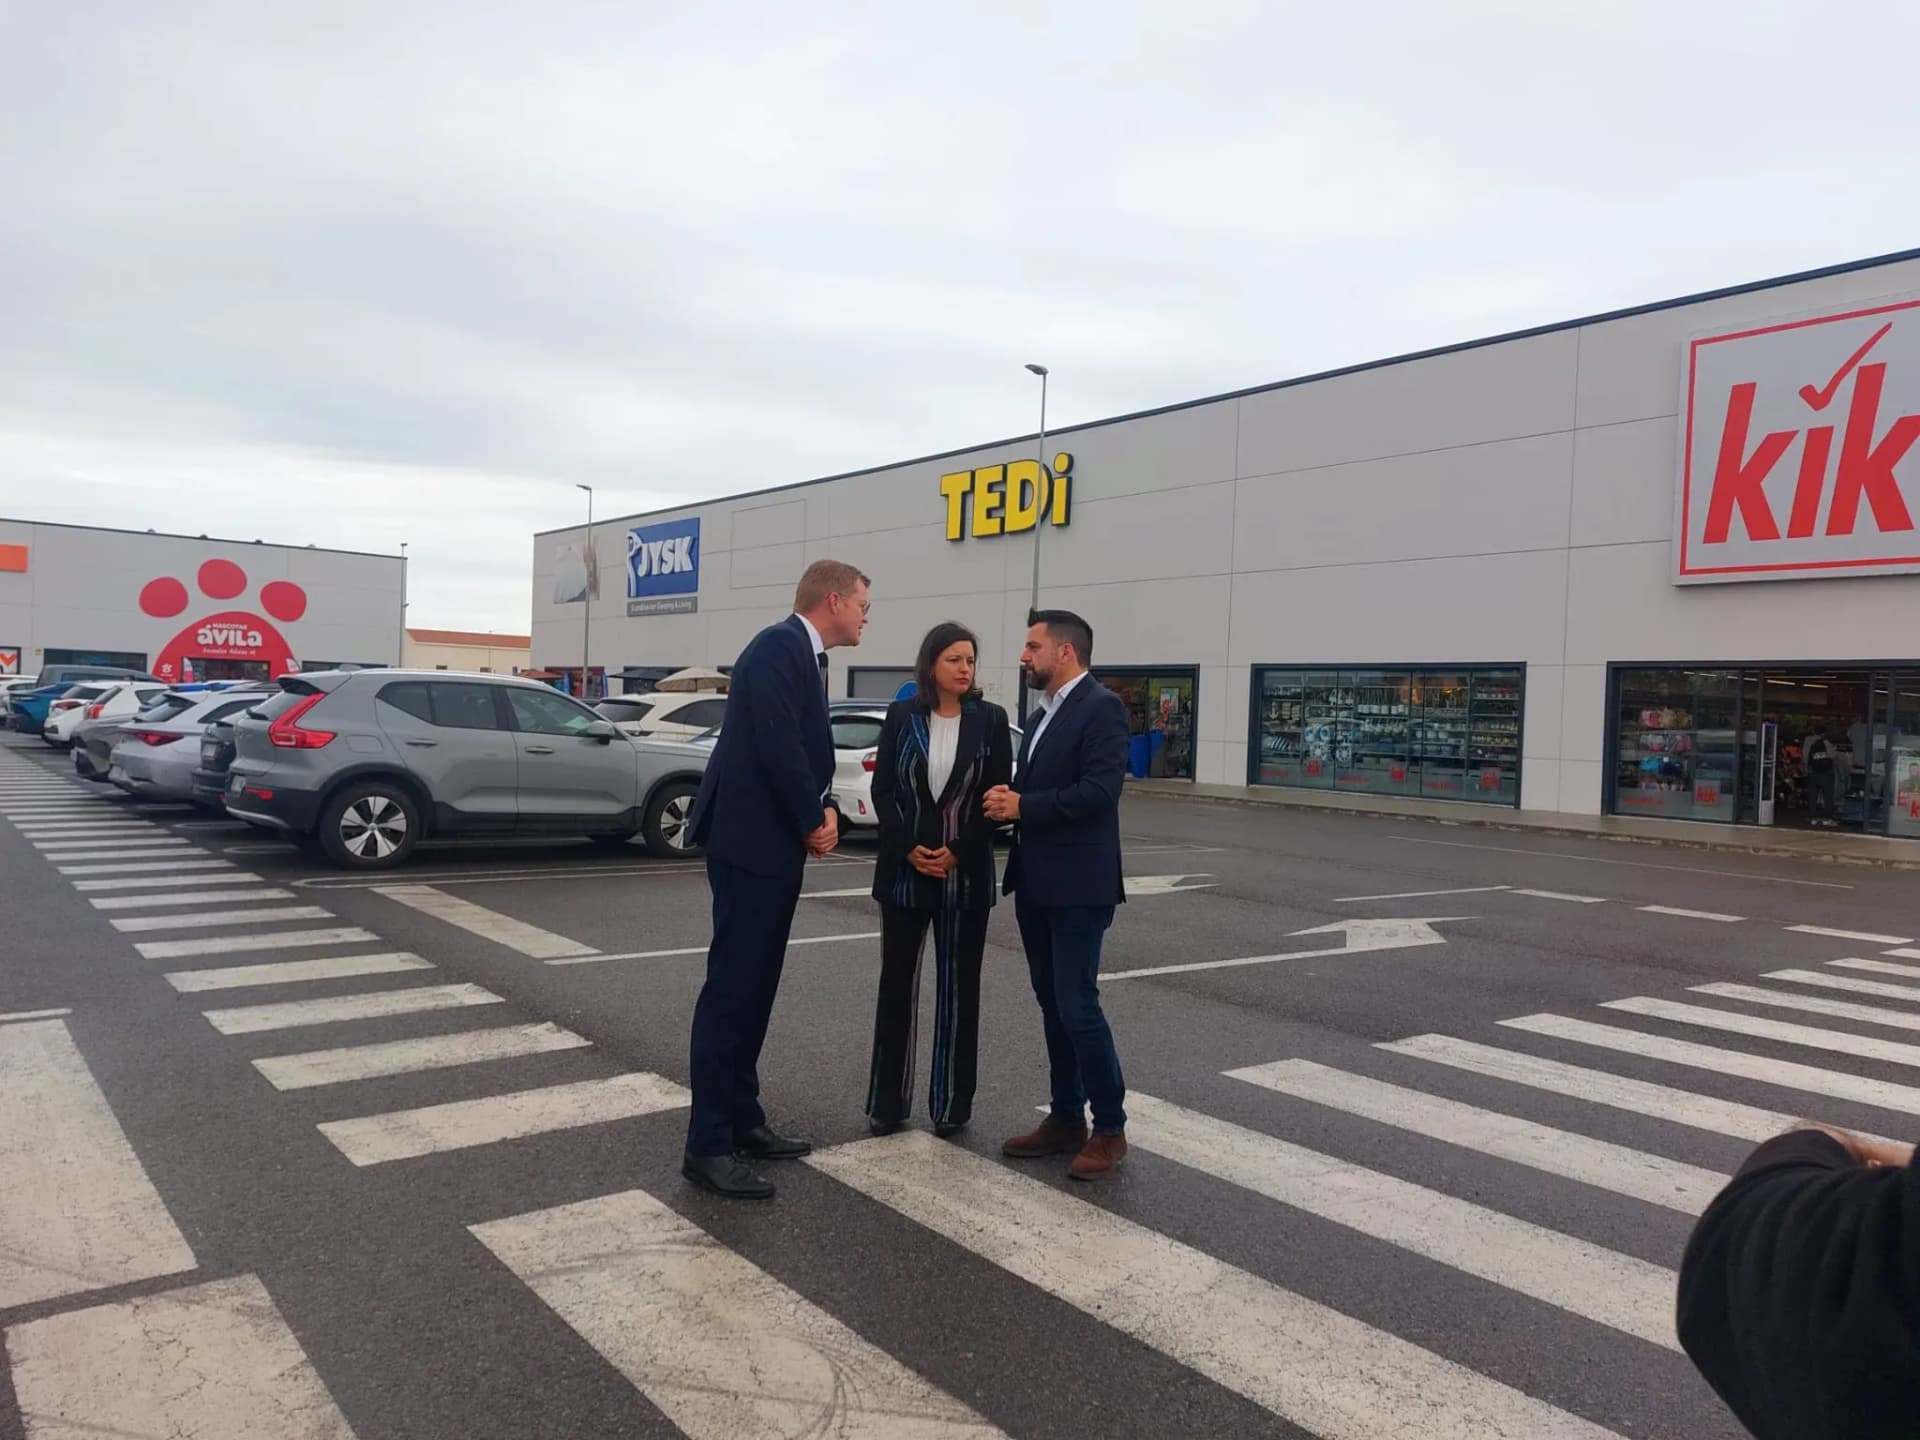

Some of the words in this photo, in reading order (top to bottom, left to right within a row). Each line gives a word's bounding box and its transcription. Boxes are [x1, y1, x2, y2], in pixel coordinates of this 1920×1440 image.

[1702, 322, 1920, 544] kik
[940, 452, 1074, 541] TEDi
[637, 536, 694, 577] JYSK
